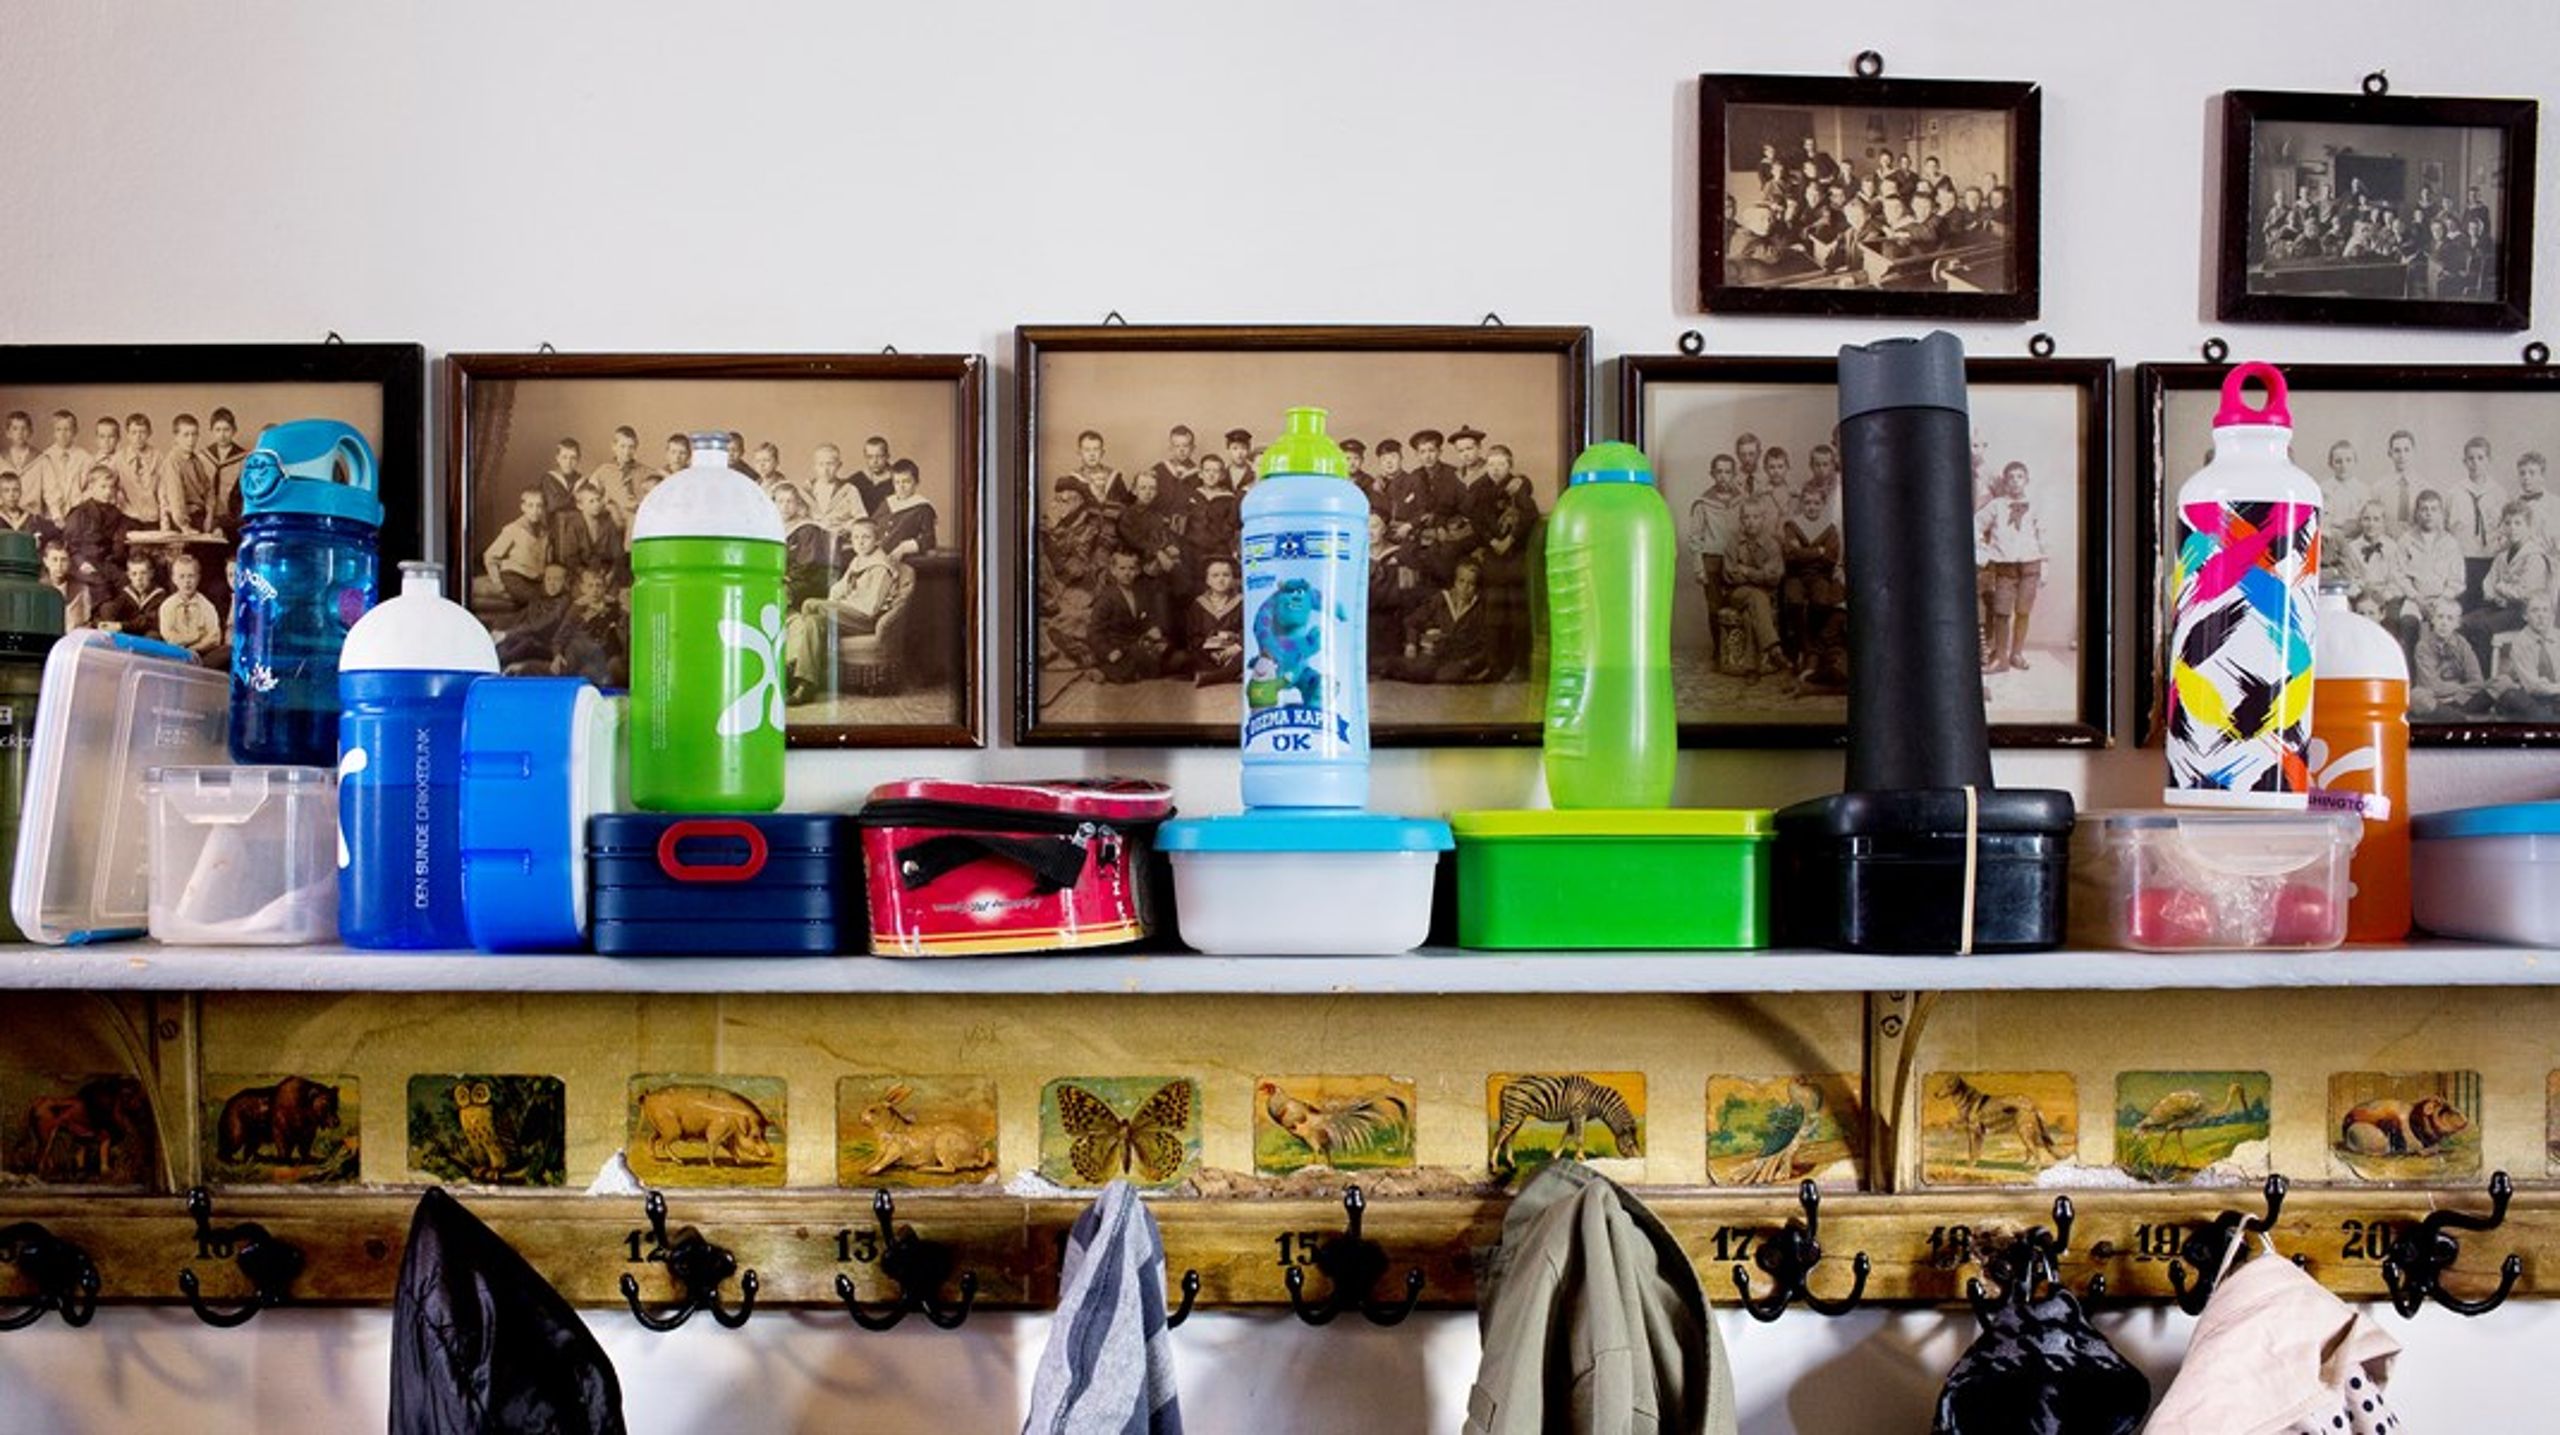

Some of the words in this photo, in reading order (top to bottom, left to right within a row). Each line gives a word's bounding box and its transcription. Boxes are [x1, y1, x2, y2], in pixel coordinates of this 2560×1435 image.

[416, 728, 430, 821] DRIKKEDUNK
[416, 823, 429, 876] SUNDE
[415, 877, 429, 909] DEN
[624, 1229, 668, 1263] 12
[833, 1229, 879, 1263] 13
[1275, 1231, 1320, 1266] 15
[1710, 1225, 1756, 1261] 17
[2134, 1222, 2180, 1262] 19
[2342, 1219, 2390, 1260] 20
